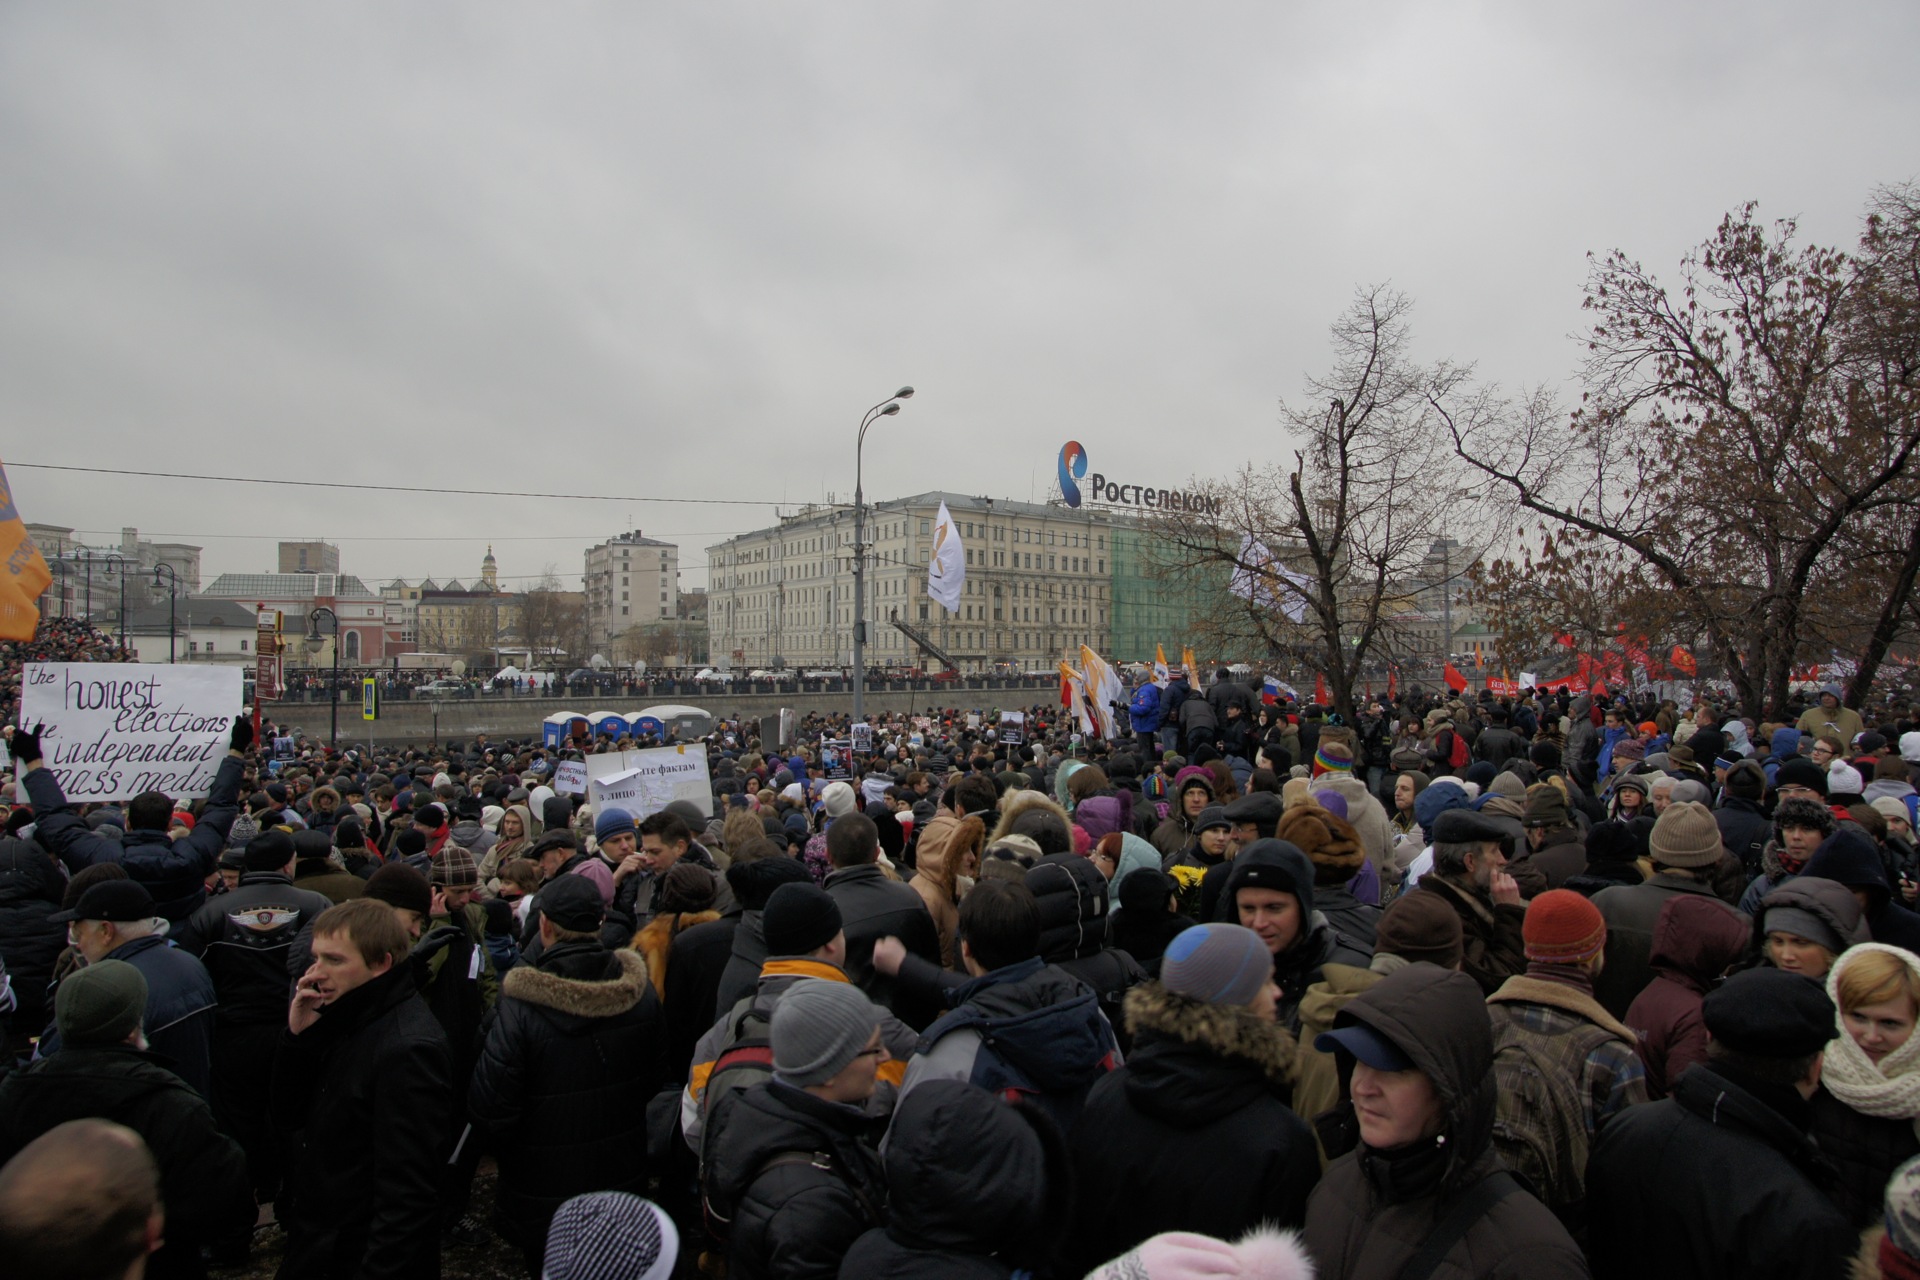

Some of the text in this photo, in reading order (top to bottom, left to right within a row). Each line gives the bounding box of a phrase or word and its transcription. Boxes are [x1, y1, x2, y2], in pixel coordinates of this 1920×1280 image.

[1092, 473, 1221, 516] Ростелеком
[29, 665, 162, 710] the honest
[114, 703, 229, 733] elections
[21, 716, 221, 770] te independent
[658, 763, 696, 777] фактам
[607, 790, 636, 802] лицо
